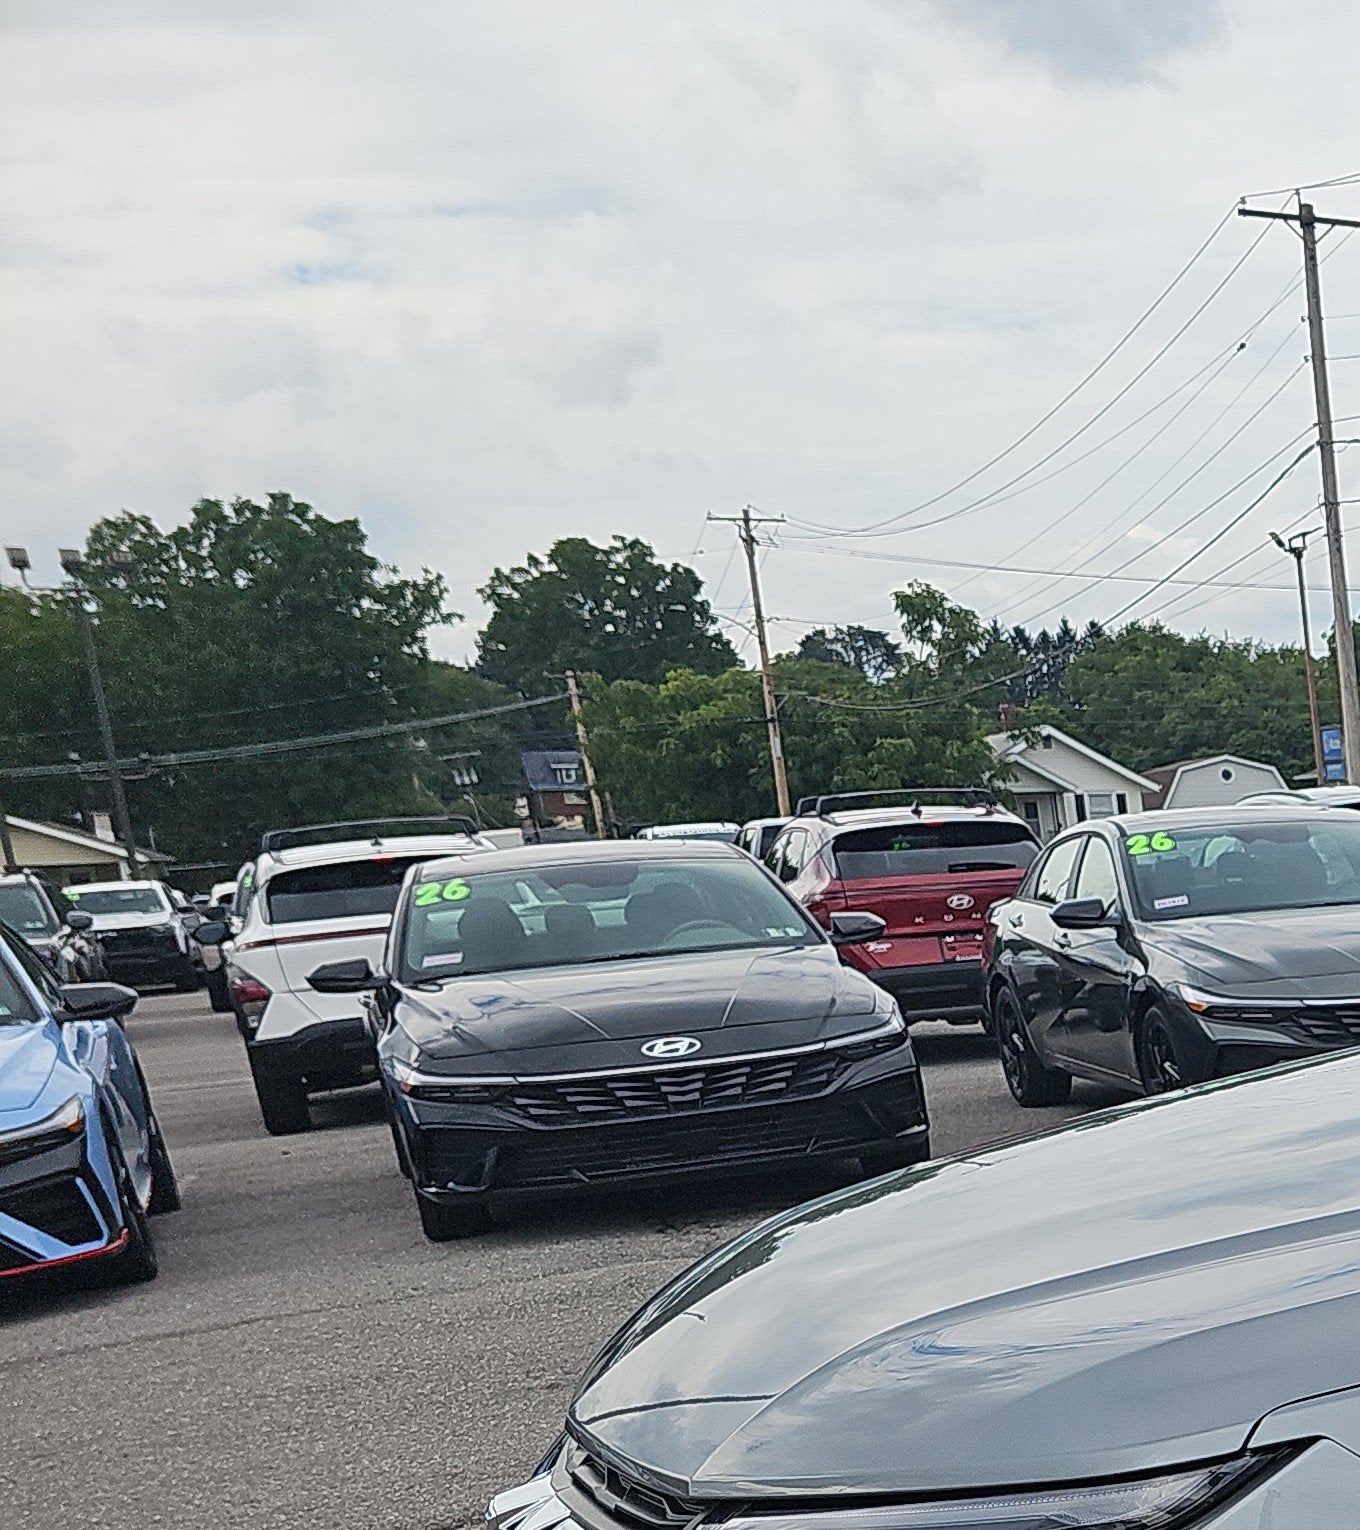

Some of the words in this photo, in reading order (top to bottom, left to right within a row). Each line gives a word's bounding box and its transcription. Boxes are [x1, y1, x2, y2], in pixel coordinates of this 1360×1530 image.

[1125, 831, 1176, 855] 26
[414, 877, 471, 907] 26
[914, 911, 982, 924] KON
